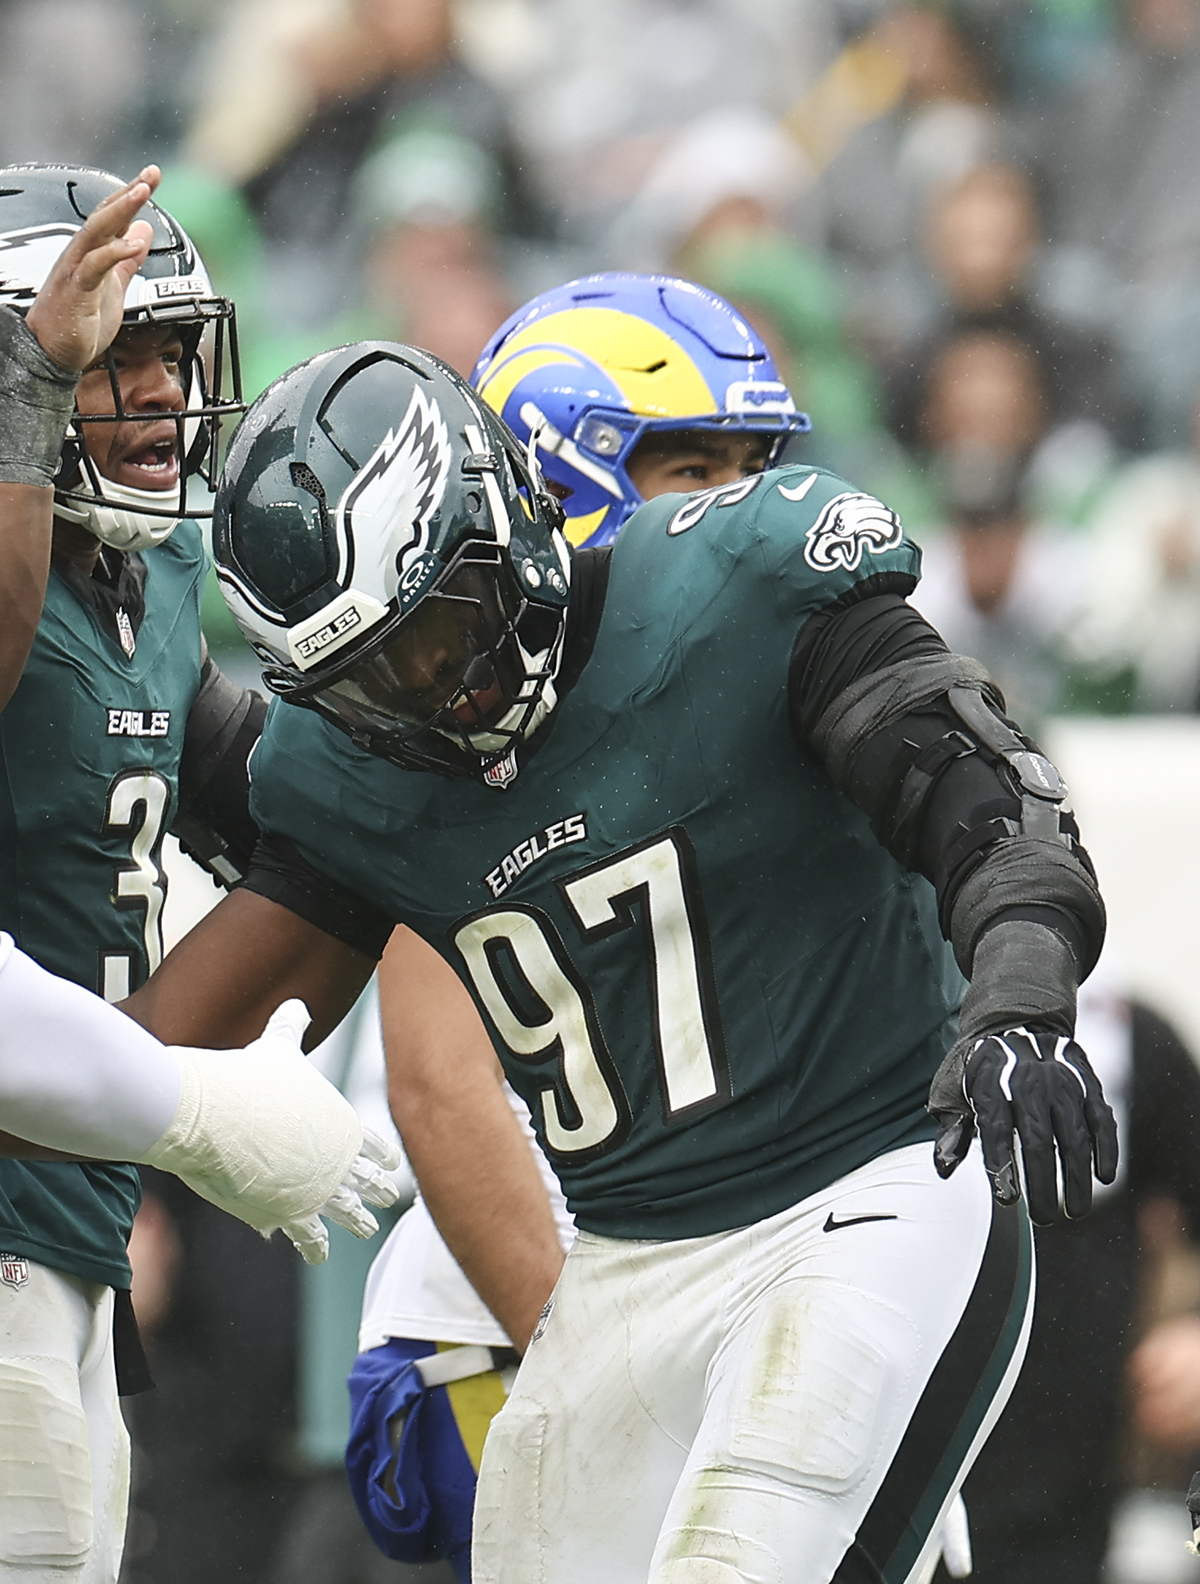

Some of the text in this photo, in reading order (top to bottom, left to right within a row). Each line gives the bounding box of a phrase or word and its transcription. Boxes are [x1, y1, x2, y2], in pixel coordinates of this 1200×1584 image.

[402, 557, 435, 603] OAKLEY
[297, 608, 360, 658] EAGLES
[107, 709, 170, 736] EAGLES
[485, 814, 586, 898] EAGLES
[452, 834, 721, 1155] 97
[3, 1262, 28, 1282] NFL
